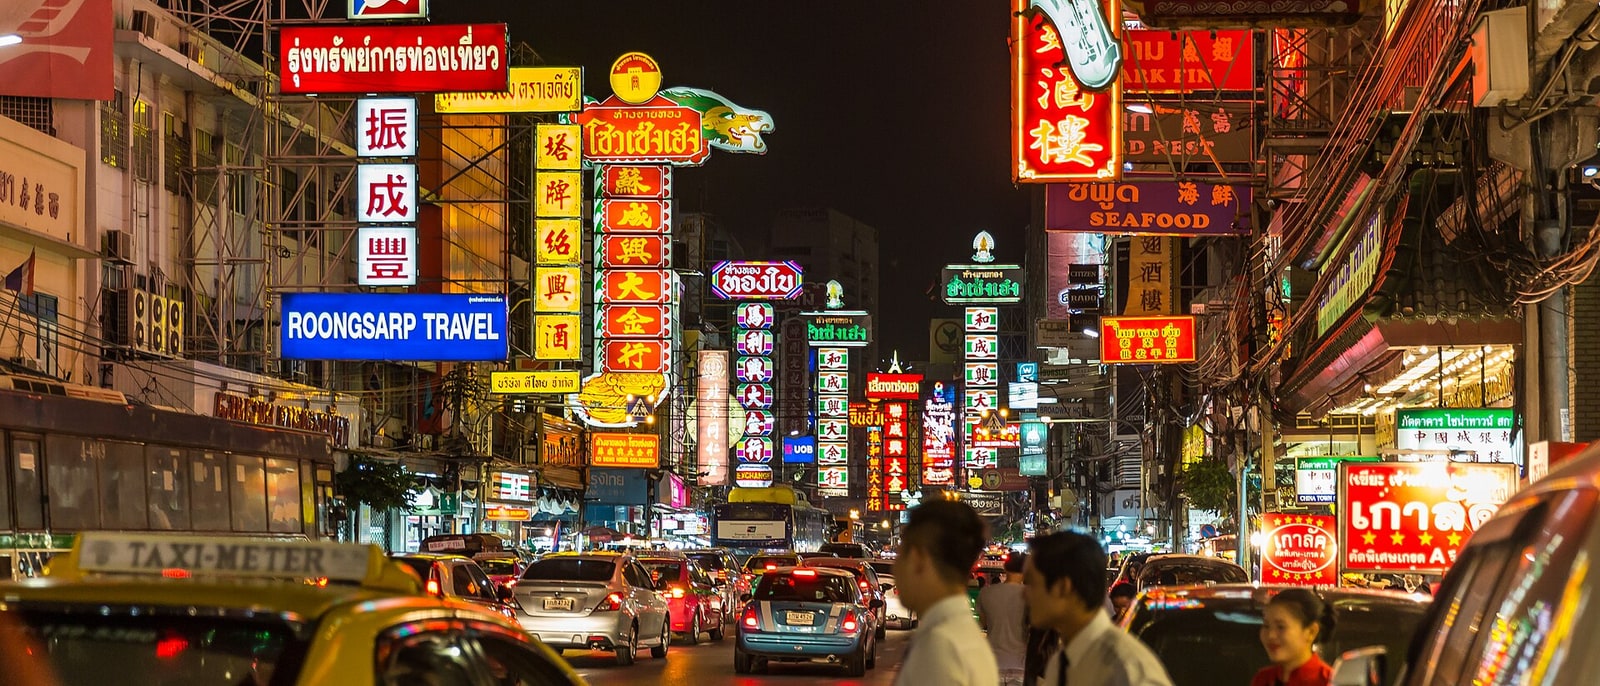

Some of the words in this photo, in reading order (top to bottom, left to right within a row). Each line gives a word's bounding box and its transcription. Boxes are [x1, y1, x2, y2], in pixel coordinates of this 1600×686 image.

[288, 26, 499, 88] รุ่งทรัพย์การท่องเที่ยว
[1173, 68, 1213, 83] FIN
[1153, 140, 1215, 155] NEST
[366, 108, 408, 279] 振成豐
[1177, 182, 1233, 207] 海鮮
[1089, 211, 1210, 229] SEAFOOD
[288, 311, 417, 340] ROONGSARP
[422, 311, 499, 340] TRAVEL
[974, 312, 990, 466] 和成興大行
[793, 444, 813, 454] UOB
[888, 404, 903, 509] 聯成興大金
[736, 471, 772, 480] EXCHANGE
[129, 542, 326, 574] TAXI-METER
[1429, 547, 1446, 564] A
